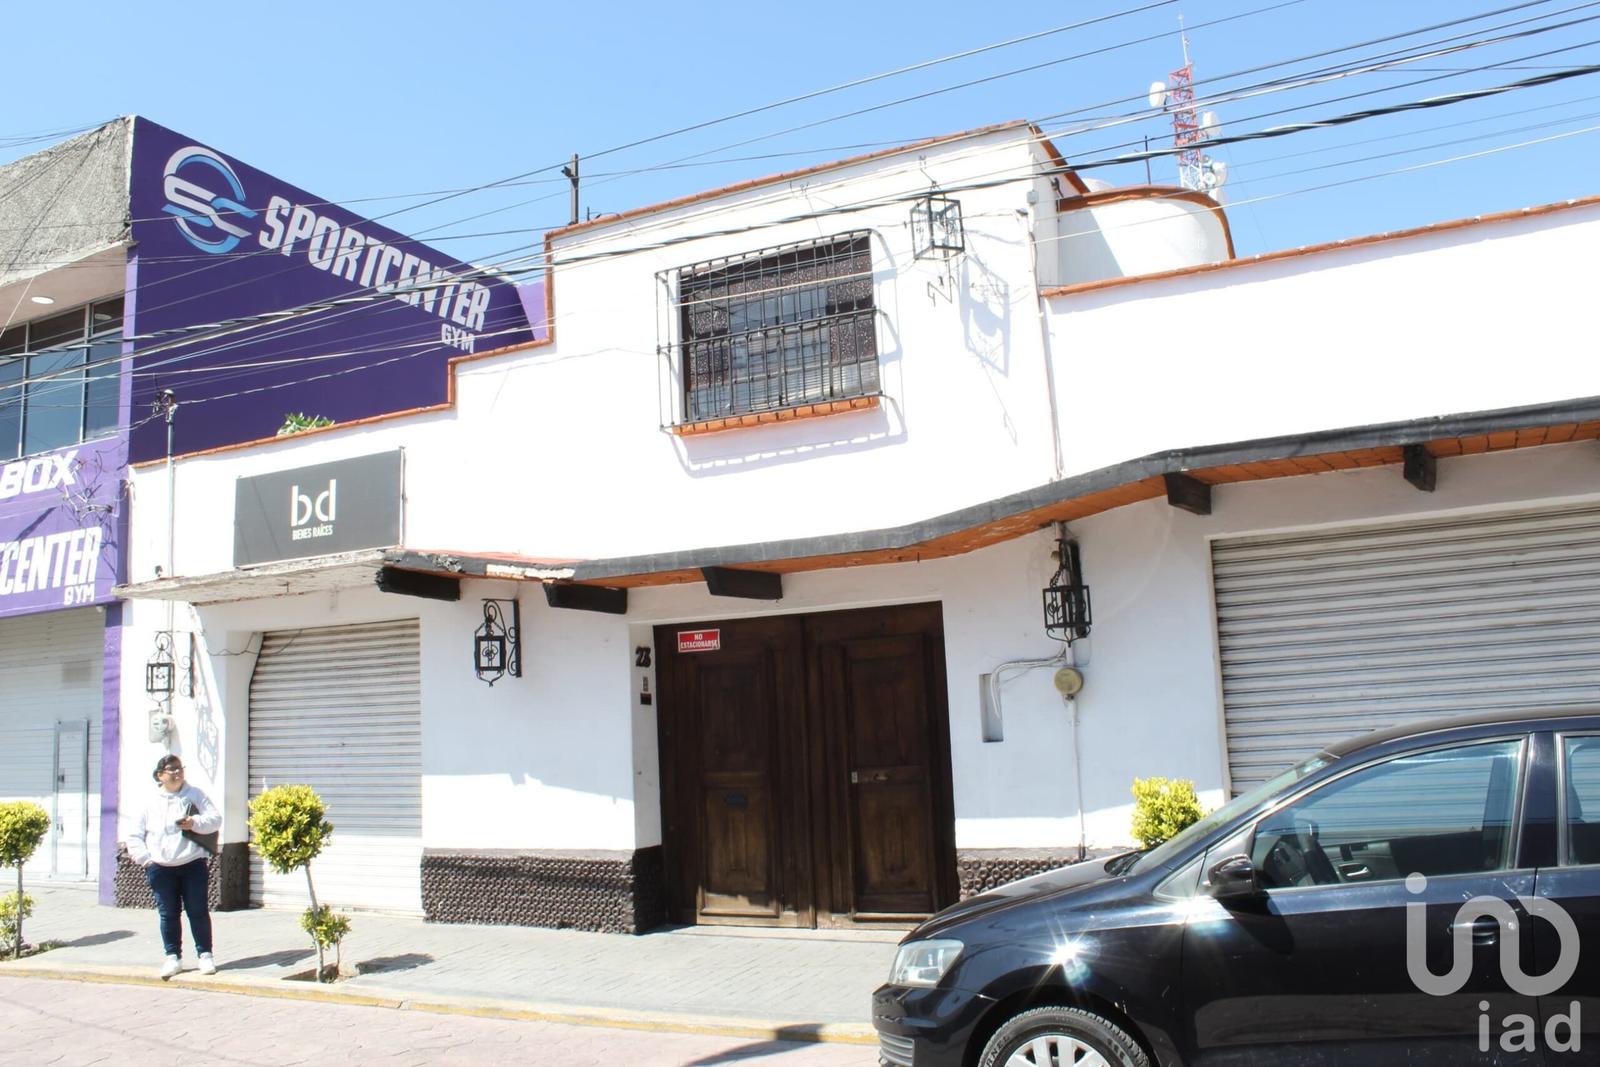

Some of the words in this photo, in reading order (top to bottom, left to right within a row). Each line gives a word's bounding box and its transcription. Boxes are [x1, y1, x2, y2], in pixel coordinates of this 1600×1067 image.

[258, 195, 491, 332] SPORTCENTER
[441, 323, 475, 354] GYM
[0, 450, 78, 499] BOX
[291, 479, 337, 527] bd
[635, 646, 651, 668] 23
[680, 640, 718, 649] ESTACIONARSE
